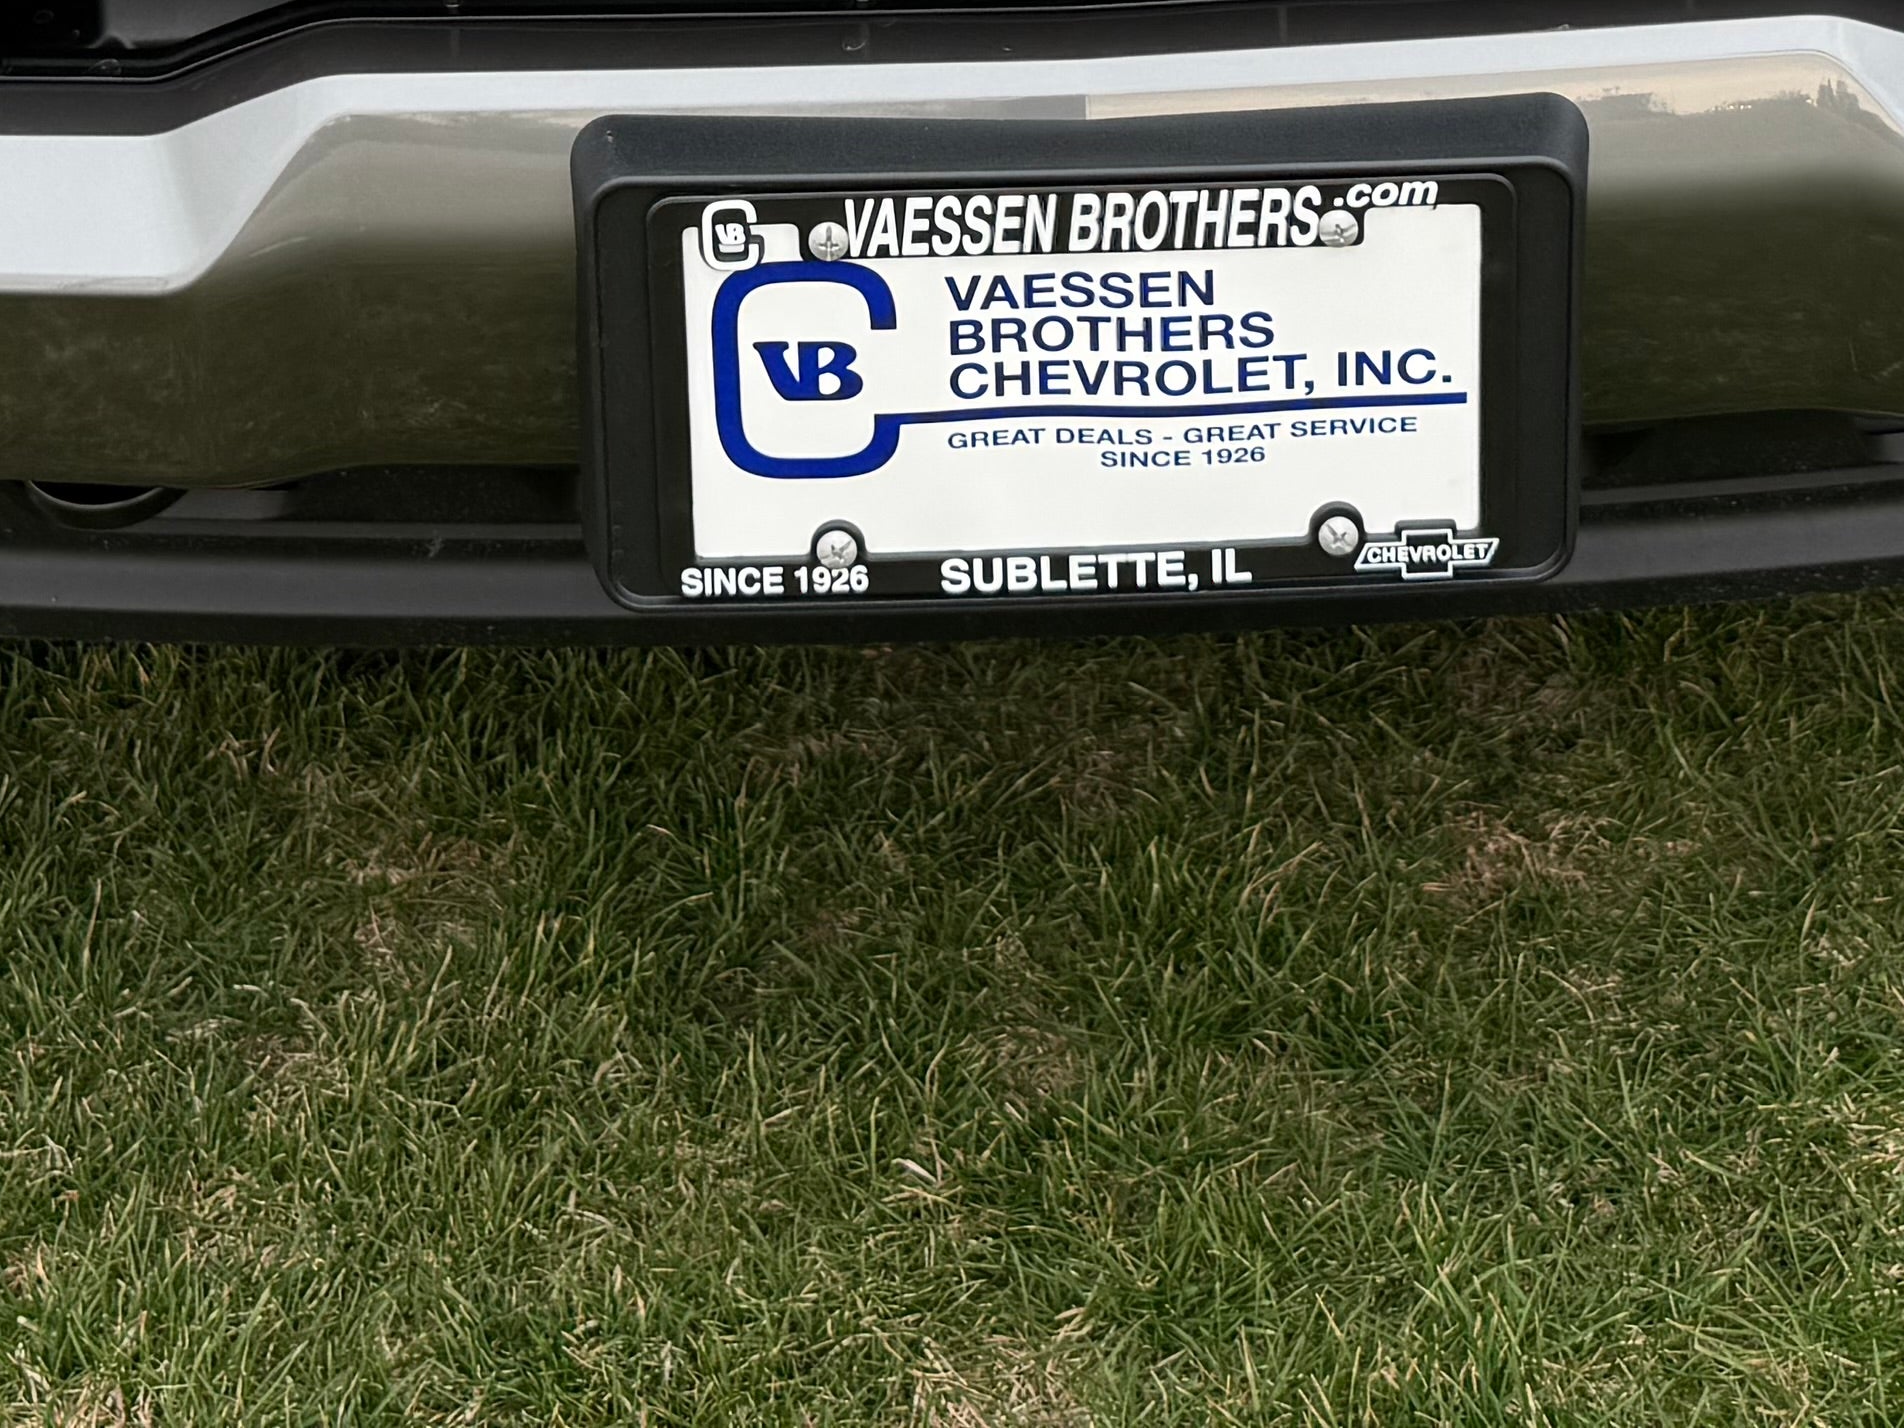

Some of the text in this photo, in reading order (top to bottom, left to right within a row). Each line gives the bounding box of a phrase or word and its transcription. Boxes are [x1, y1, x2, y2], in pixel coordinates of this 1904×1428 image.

[844, 193, 1058, 258] VAESSEN
[1068, 185, 1322, 252] BROTHERS
[944, 269, 1215, 312] VAESSEN
[949, 311, 1275, 356] BROTHERS
[752, 341, 864, 401] VB
[949, 348, 1454, 400] CHEVROLET, INC.
[947, 427, 1047, 449] GREAT
[1055, 427, 1153, 446] DEALS
[1183, 422, 1283, 444] GREAT
[1290, 416, 1419, 438] SERVICE
[1100, 446, 1267, 468] SINCE 1926
[940, 547, 1253, 595] SUBLETTE, IL
[1367, 542, 1490, 564] CHEVROLET
[680, 565, 870, 598] SINCE 1926
